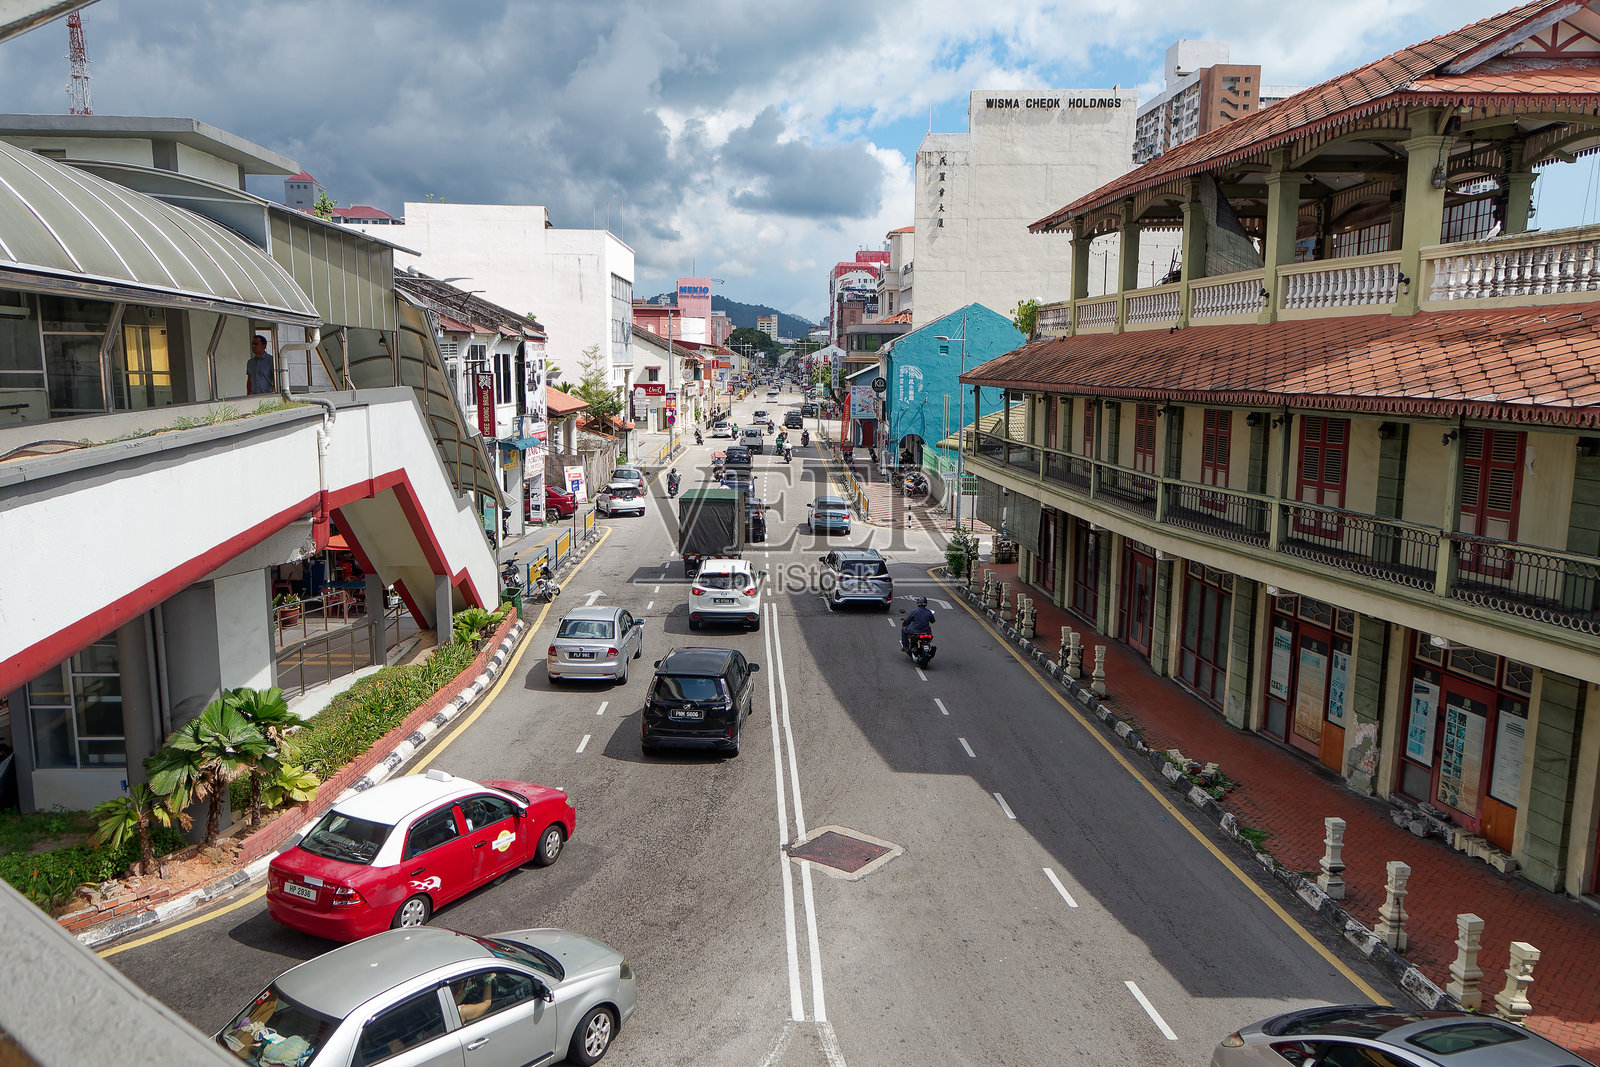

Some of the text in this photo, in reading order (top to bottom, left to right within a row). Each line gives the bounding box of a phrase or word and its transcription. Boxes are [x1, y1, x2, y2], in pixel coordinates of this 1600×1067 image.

[985, 98, 1122, 109] WISMA CHEOK HOLDINGS
